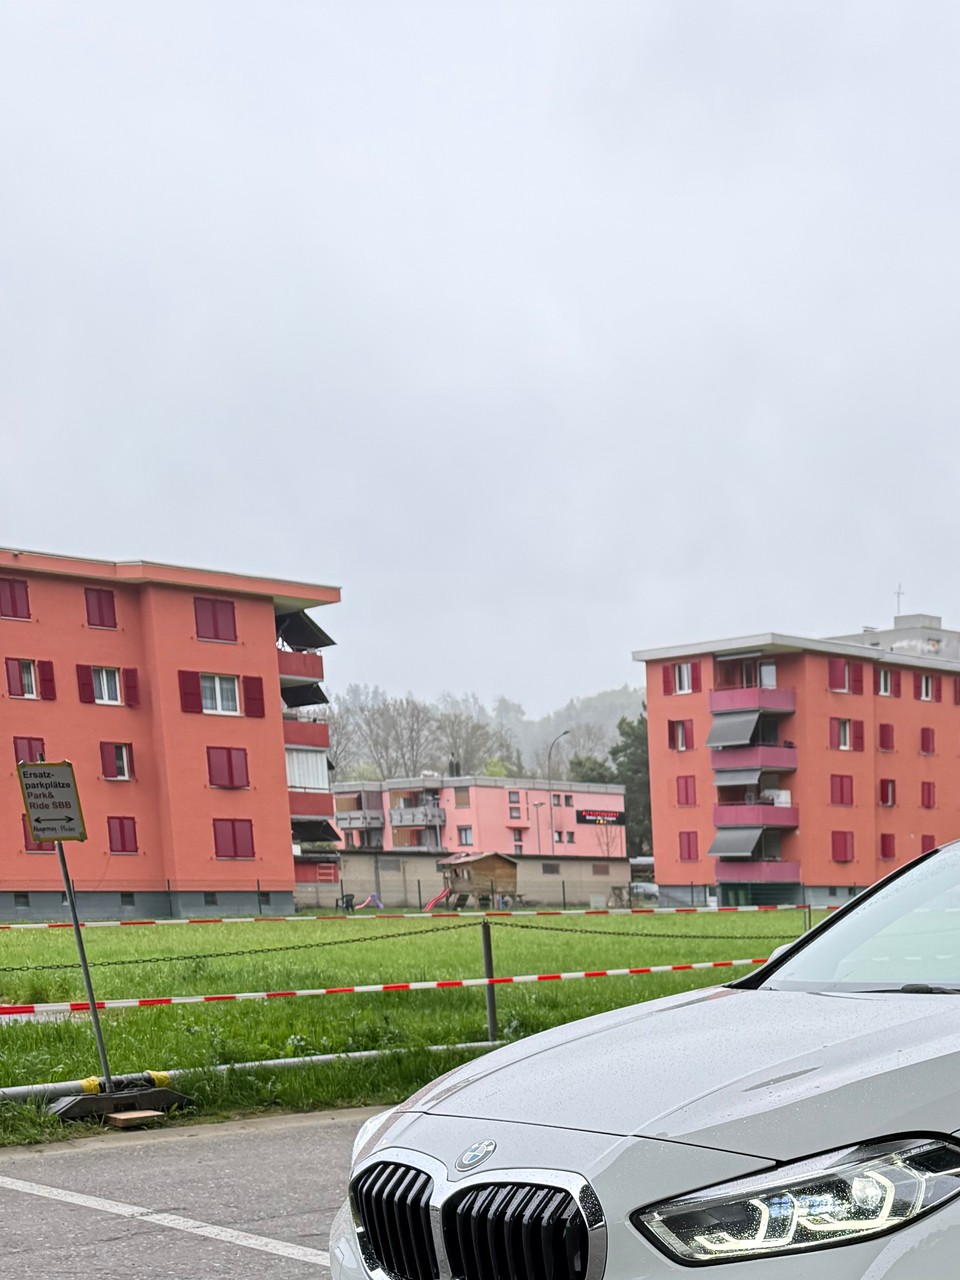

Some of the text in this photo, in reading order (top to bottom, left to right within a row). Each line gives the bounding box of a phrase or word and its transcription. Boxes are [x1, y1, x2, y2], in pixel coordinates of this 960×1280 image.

[23, 771, 55, 779] Ersatz-
[25, 781, 71, 790] parkplätze
[29, 801, 71, 810] Ride SBB
